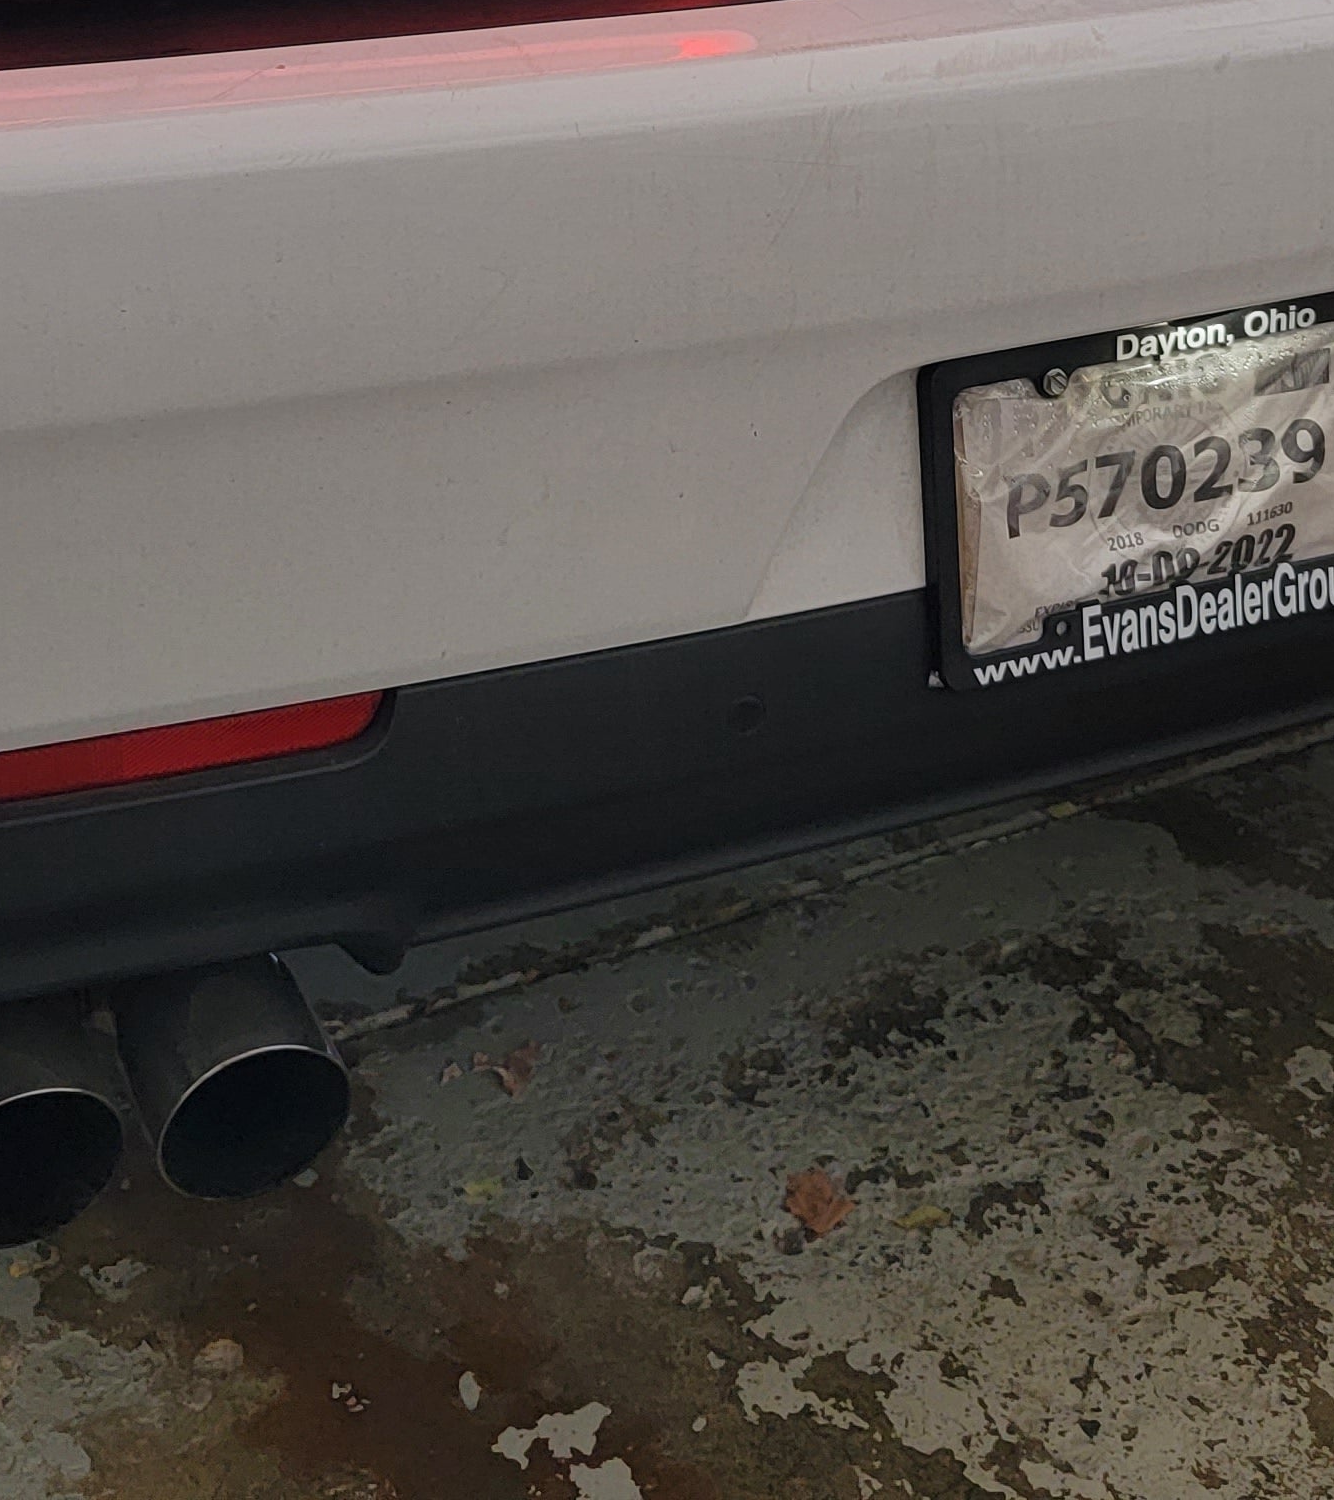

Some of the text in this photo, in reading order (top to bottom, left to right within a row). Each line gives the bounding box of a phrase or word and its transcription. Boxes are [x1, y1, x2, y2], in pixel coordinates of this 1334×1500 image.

[1116, 304, 1316, 361] Dayton, Ohio
[1005, 418, 1327, 539] P570239
[1107, 531, 1145, 551] 2018
[1172, 518, 1220, 538] DODG
